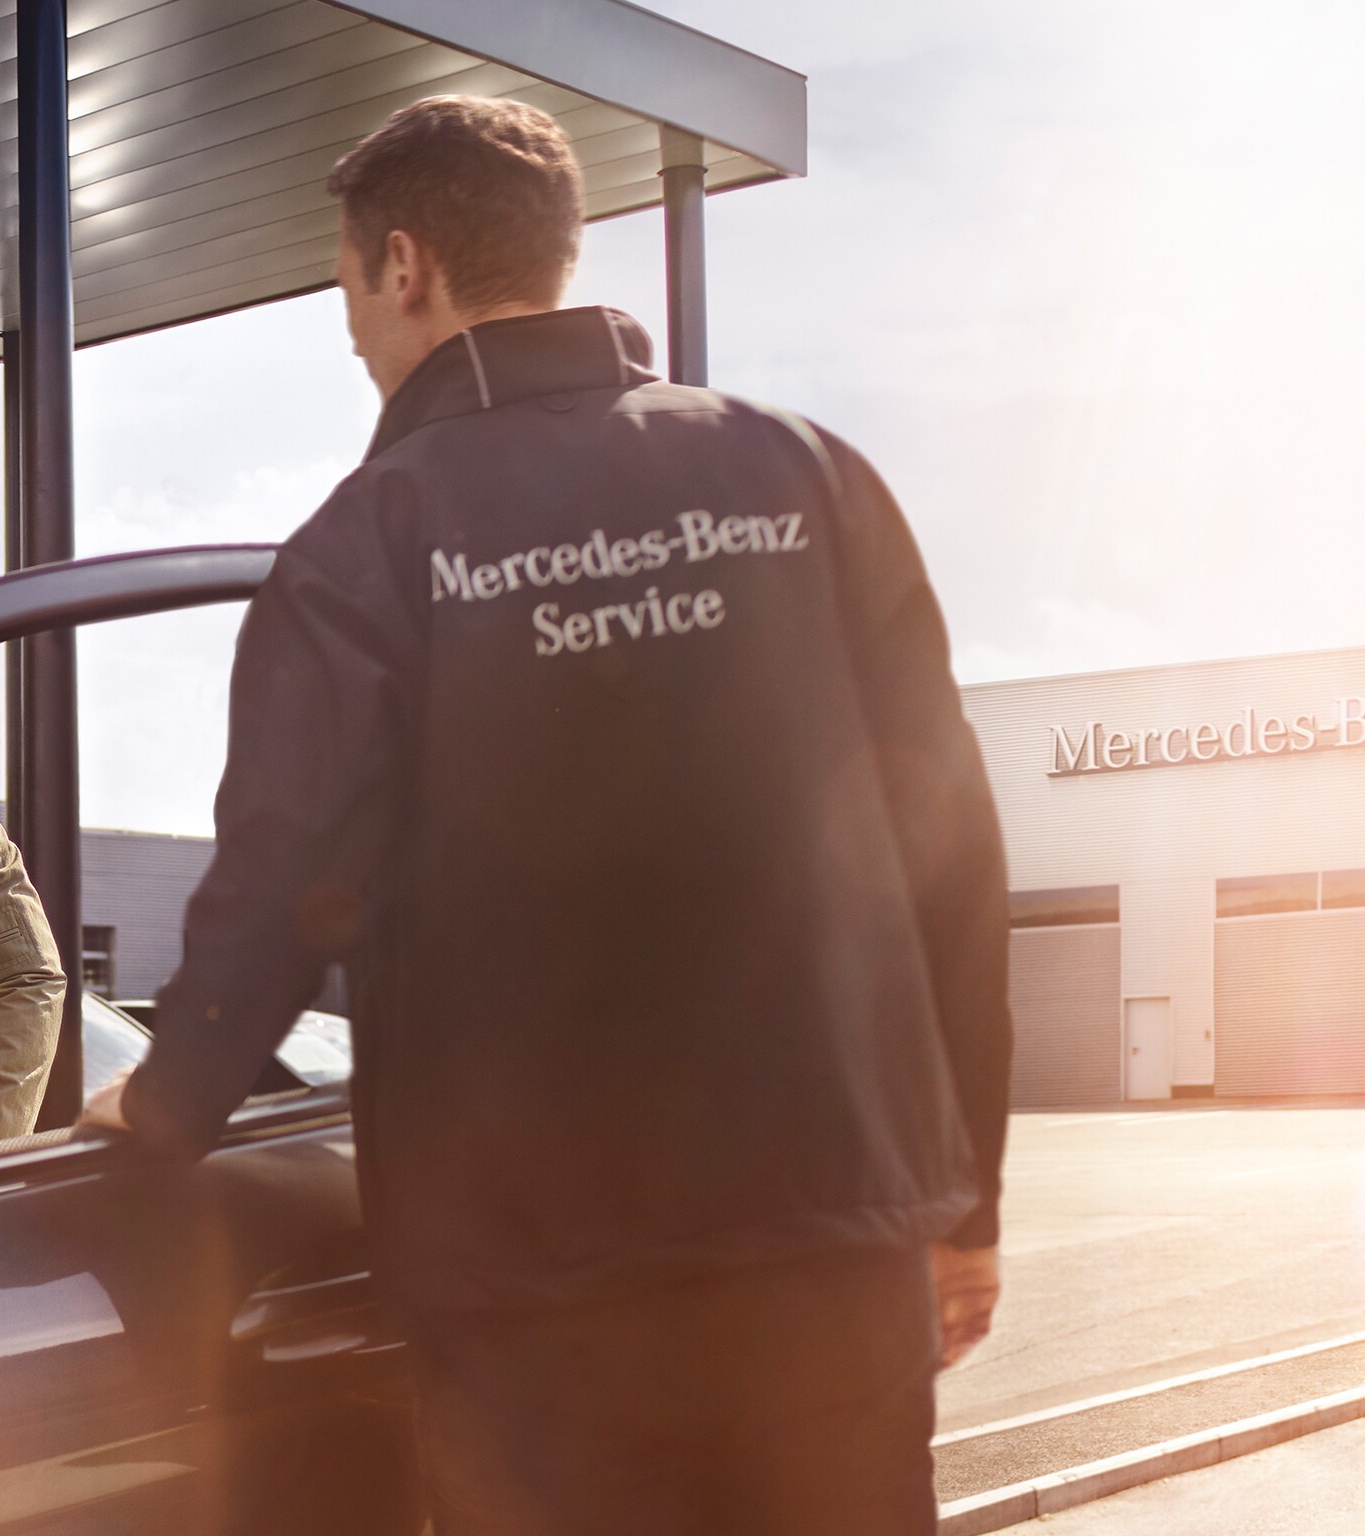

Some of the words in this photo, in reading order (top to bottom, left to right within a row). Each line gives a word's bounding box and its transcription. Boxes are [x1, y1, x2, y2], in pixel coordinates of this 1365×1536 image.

[430, 509, 809, 601] Mercedes-Benz
[532, 586, 726, 656] Service
[1048, 696, 1365, 773] Mercedes-B
